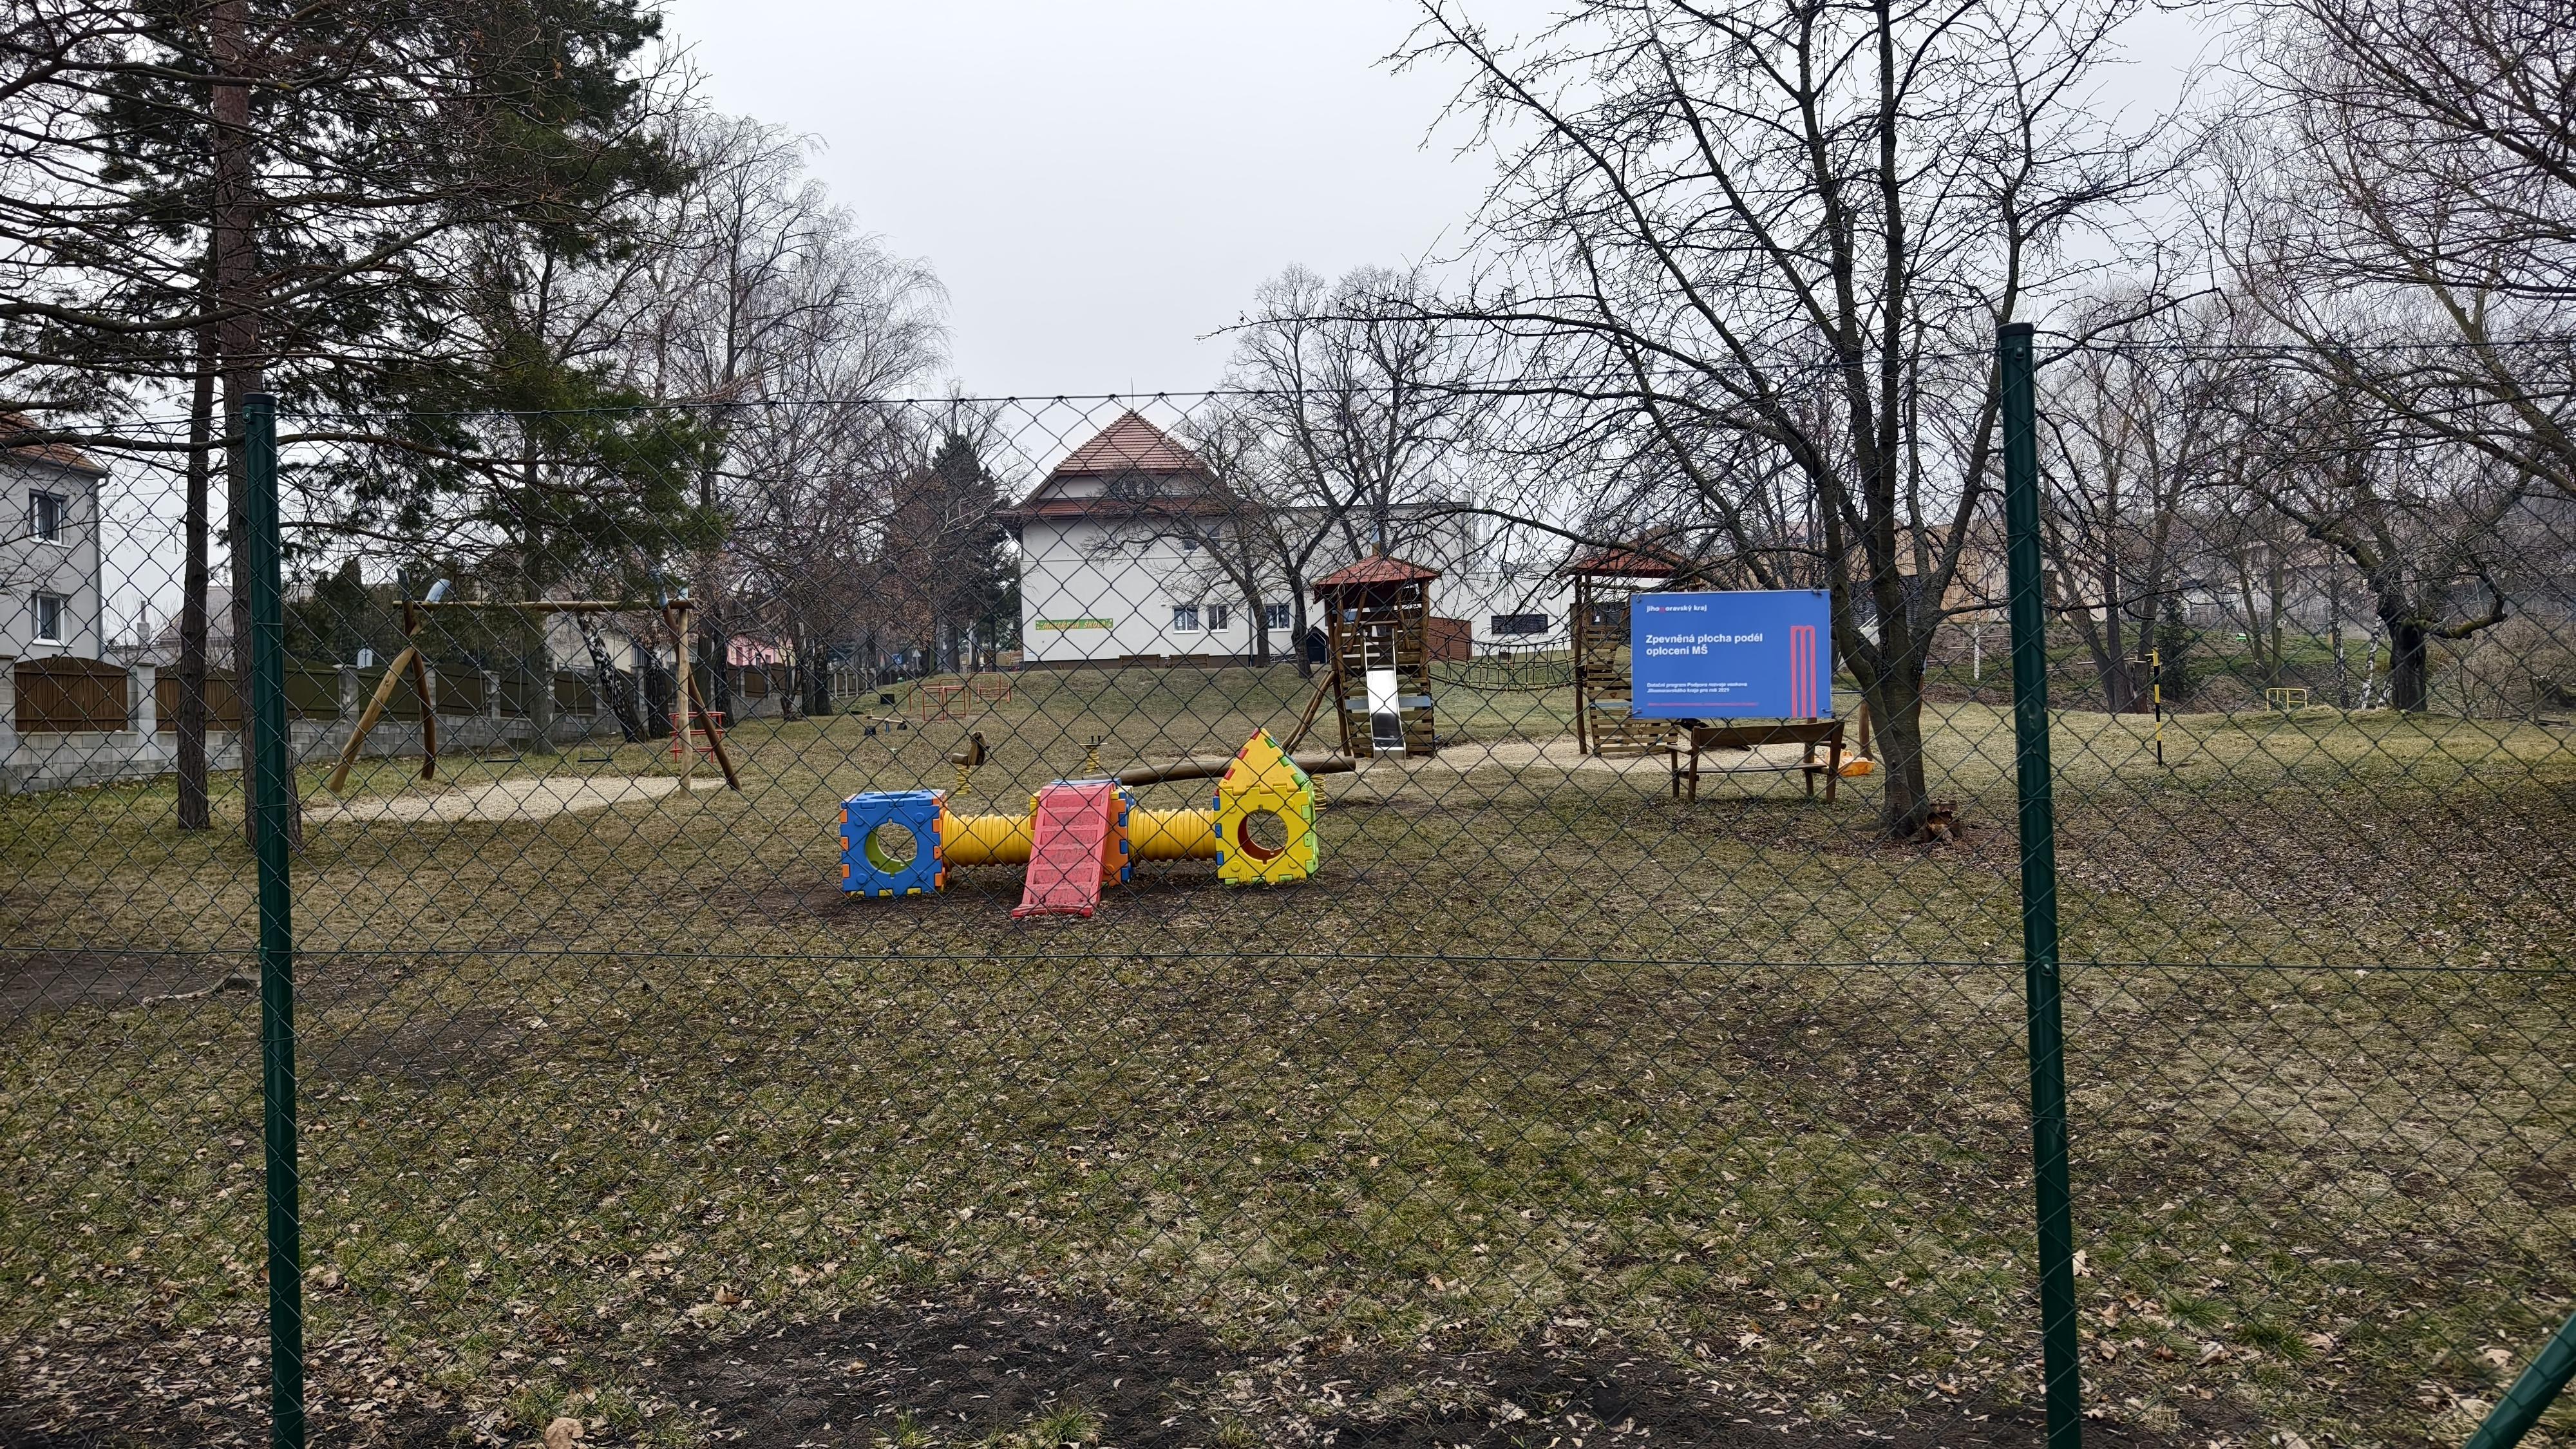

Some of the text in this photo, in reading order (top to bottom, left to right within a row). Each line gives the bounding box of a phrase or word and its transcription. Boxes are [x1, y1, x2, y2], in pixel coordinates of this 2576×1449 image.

[1645, 633, 1763, 645] Zpevněná plocha podél
[1646, 644, 1708, 657] oplocení MŠ
